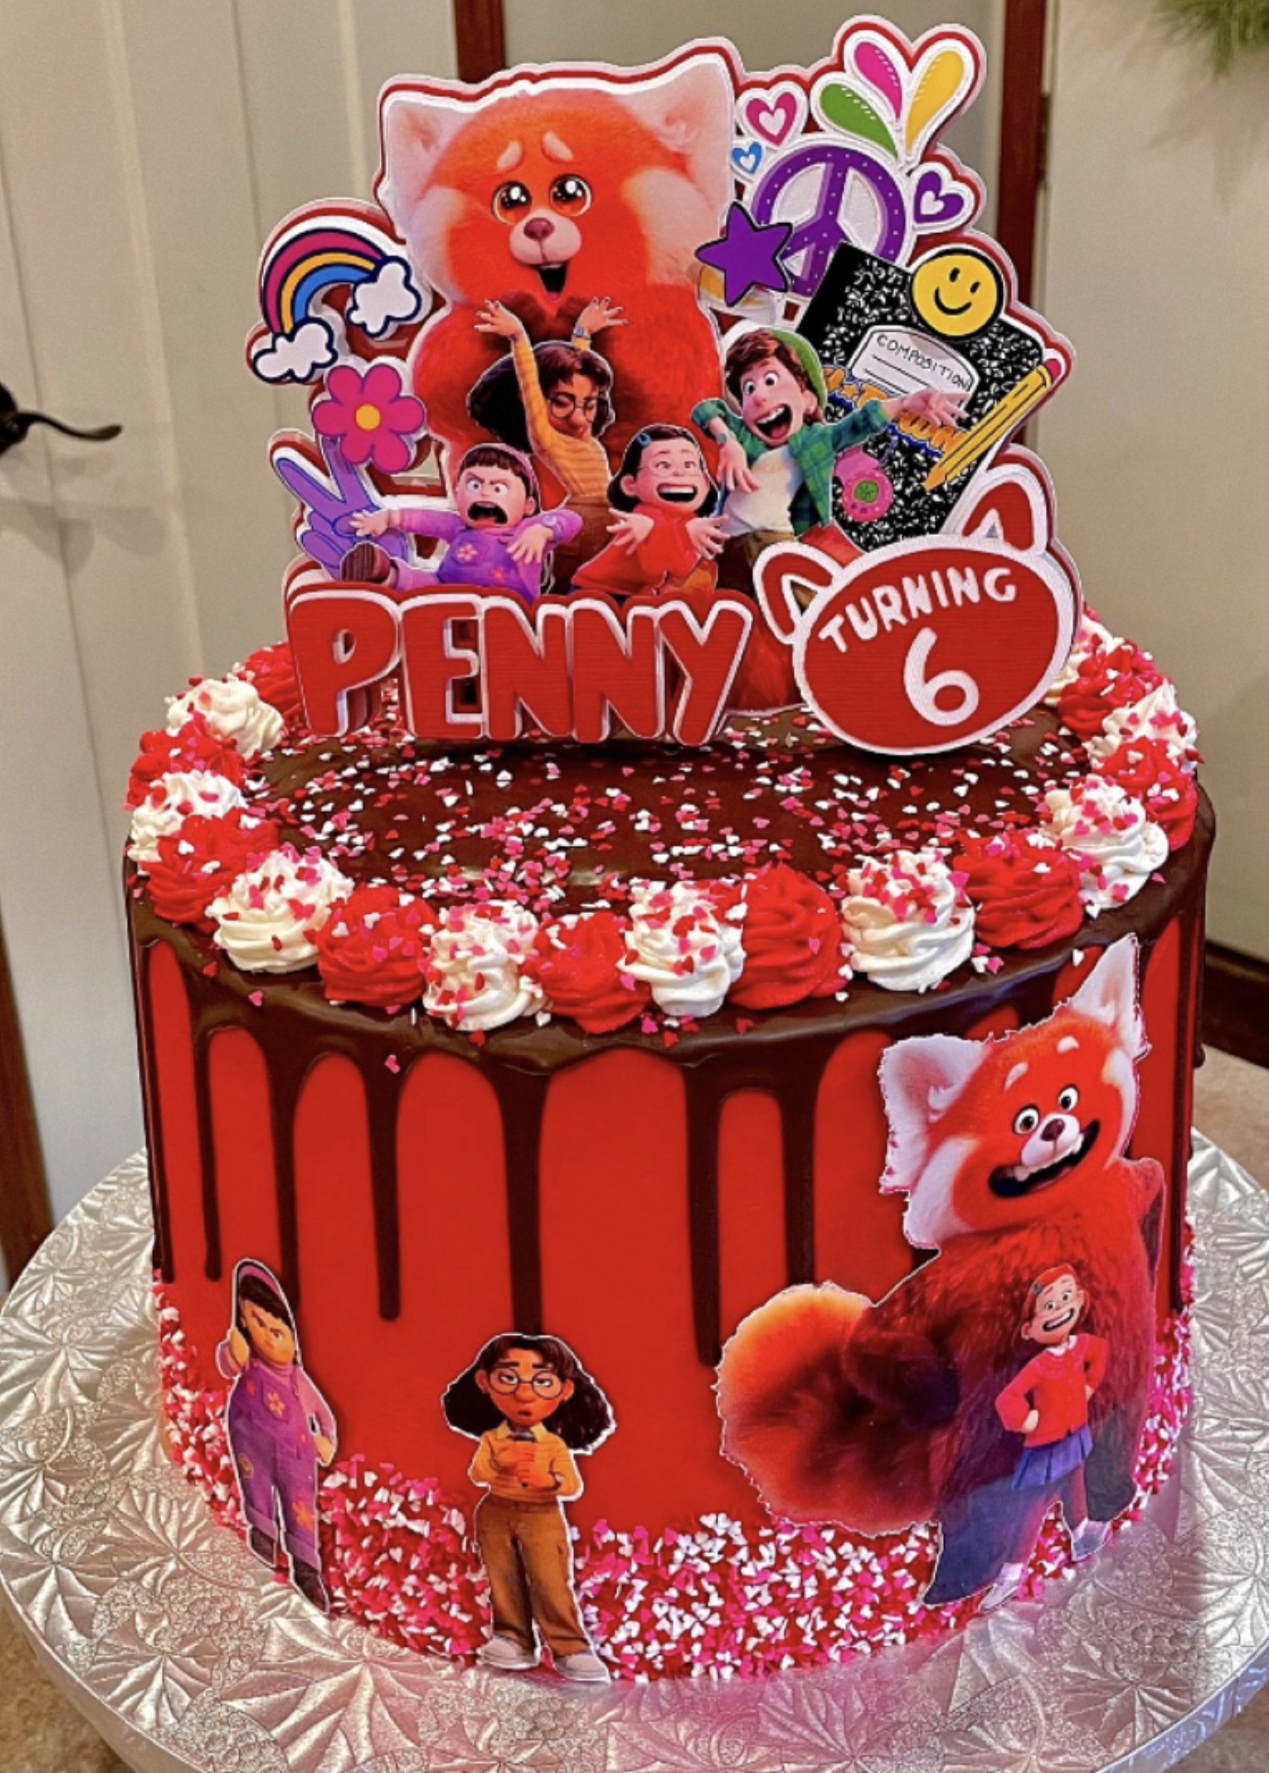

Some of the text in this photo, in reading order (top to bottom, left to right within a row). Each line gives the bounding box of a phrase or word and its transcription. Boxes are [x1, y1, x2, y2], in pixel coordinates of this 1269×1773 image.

[876, 333, 970, 392] COMPOSITION
[818, 566, 1016, 652] TURNING
[289, 594, 752, 746] PENNY
[903, 627, 979, 726] 6
